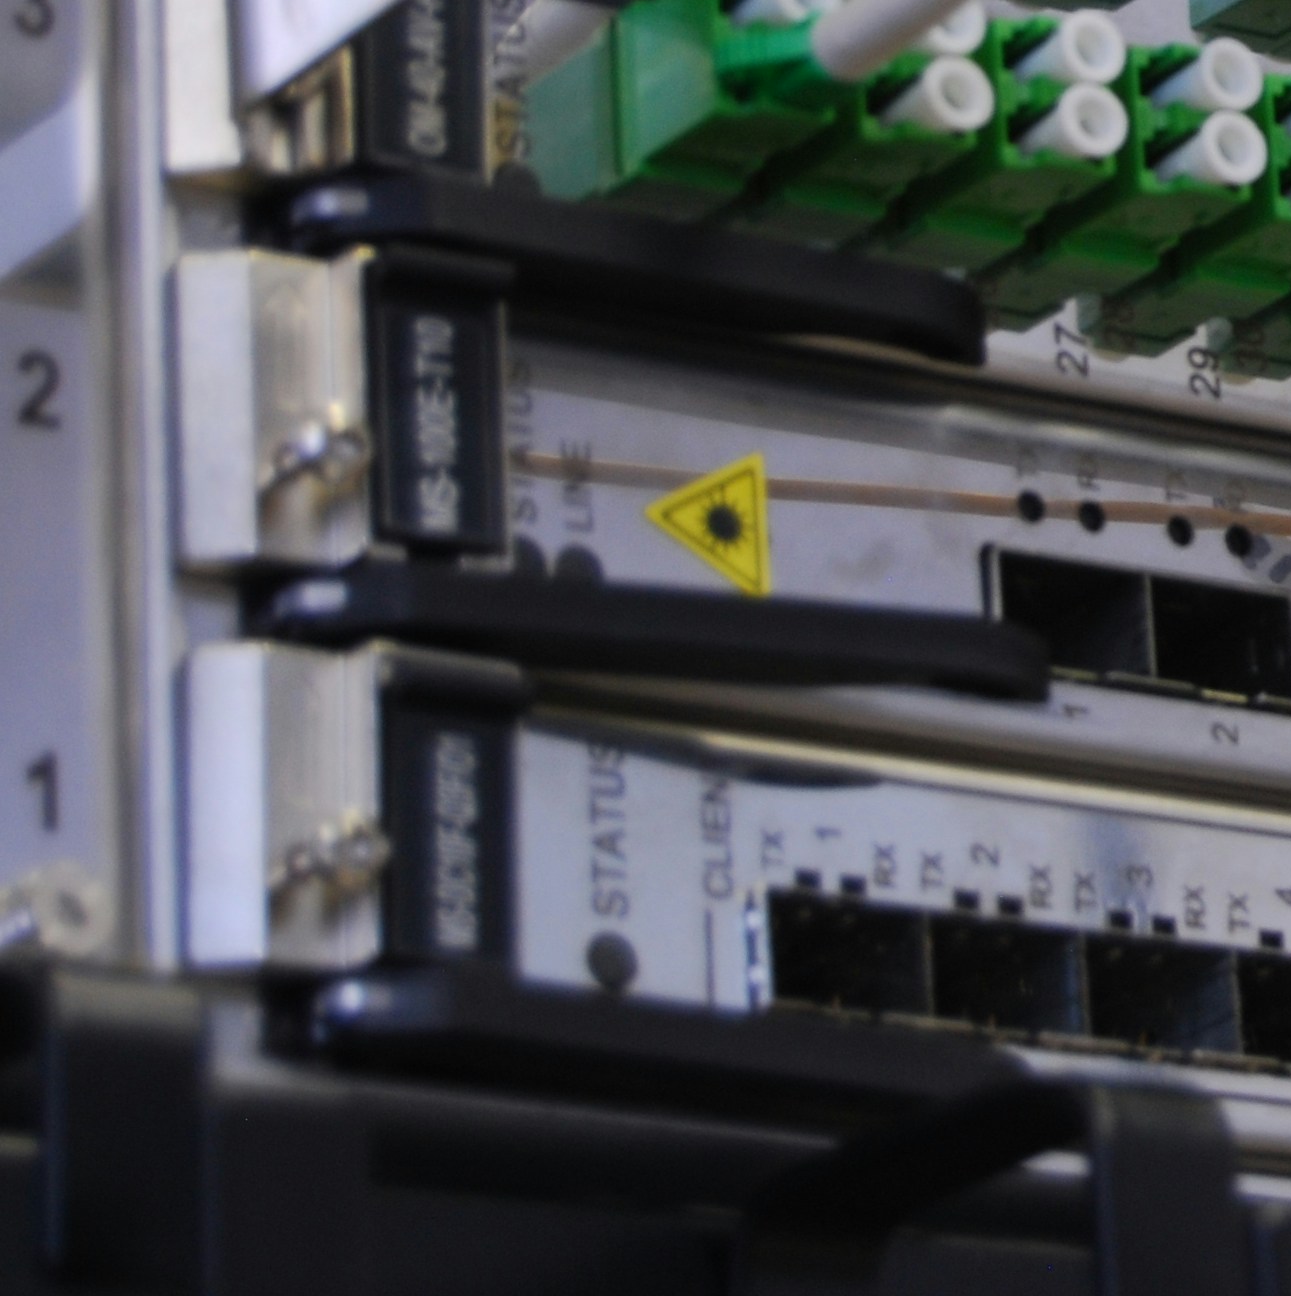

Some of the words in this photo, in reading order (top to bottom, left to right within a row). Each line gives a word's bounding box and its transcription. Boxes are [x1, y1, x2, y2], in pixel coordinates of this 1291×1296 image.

[1053, 320, 1088, 378] 27
[1187, 346, 1222, 399] 29
[17, 352, 60, 426] 2
[1210, 722, 1239, 746] 2
[27, 753, 60, 831] 1
